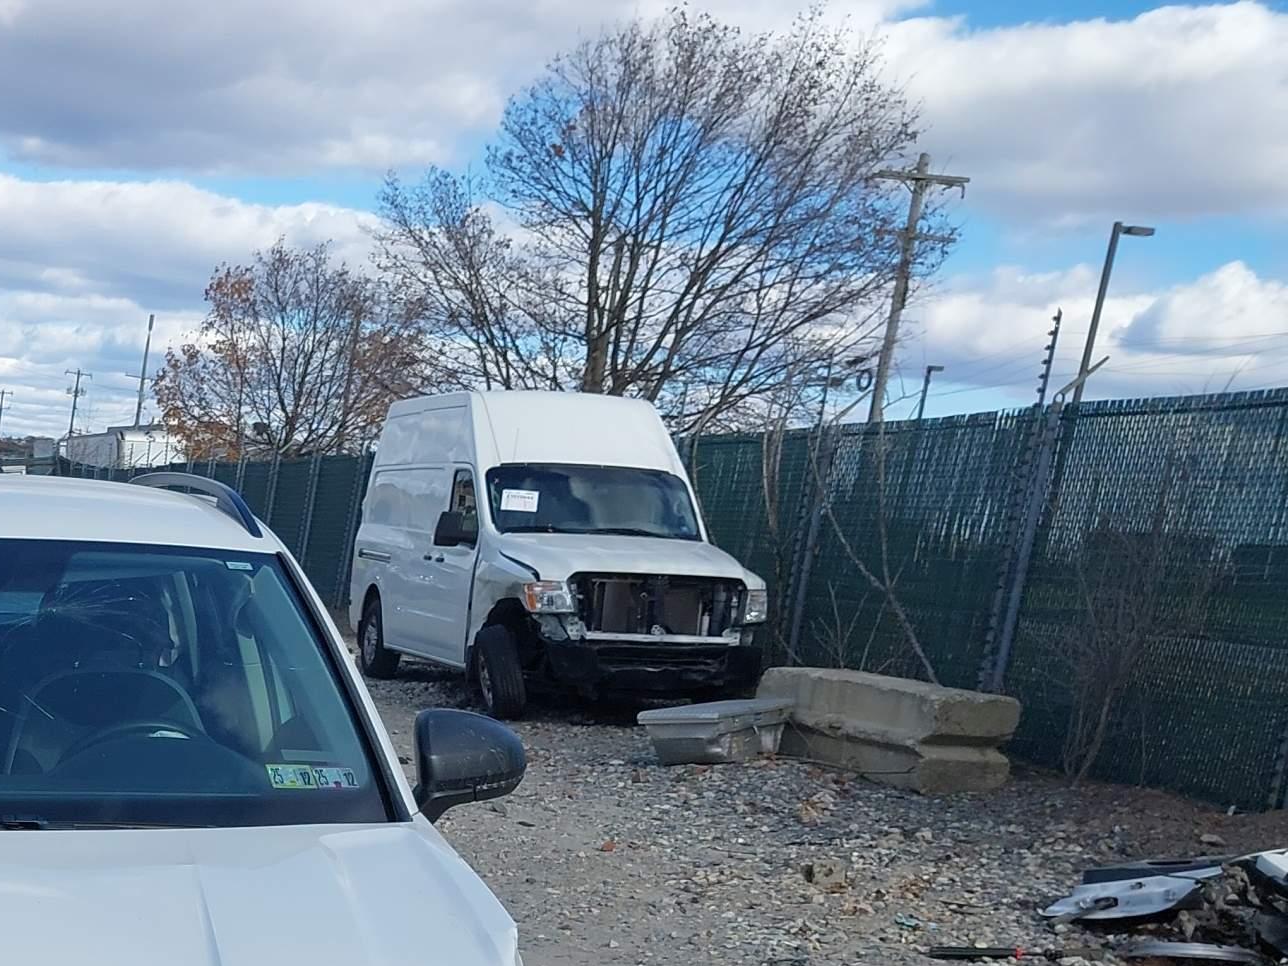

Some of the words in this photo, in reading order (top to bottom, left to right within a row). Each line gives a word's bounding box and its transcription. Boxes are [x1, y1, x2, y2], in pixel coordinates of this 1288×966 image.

[270, 768, 284, 784] 25
[300, 771, 313, 785] 12
[314, 769, 329, 785] 25
[343, 772, 358, 786] 12
